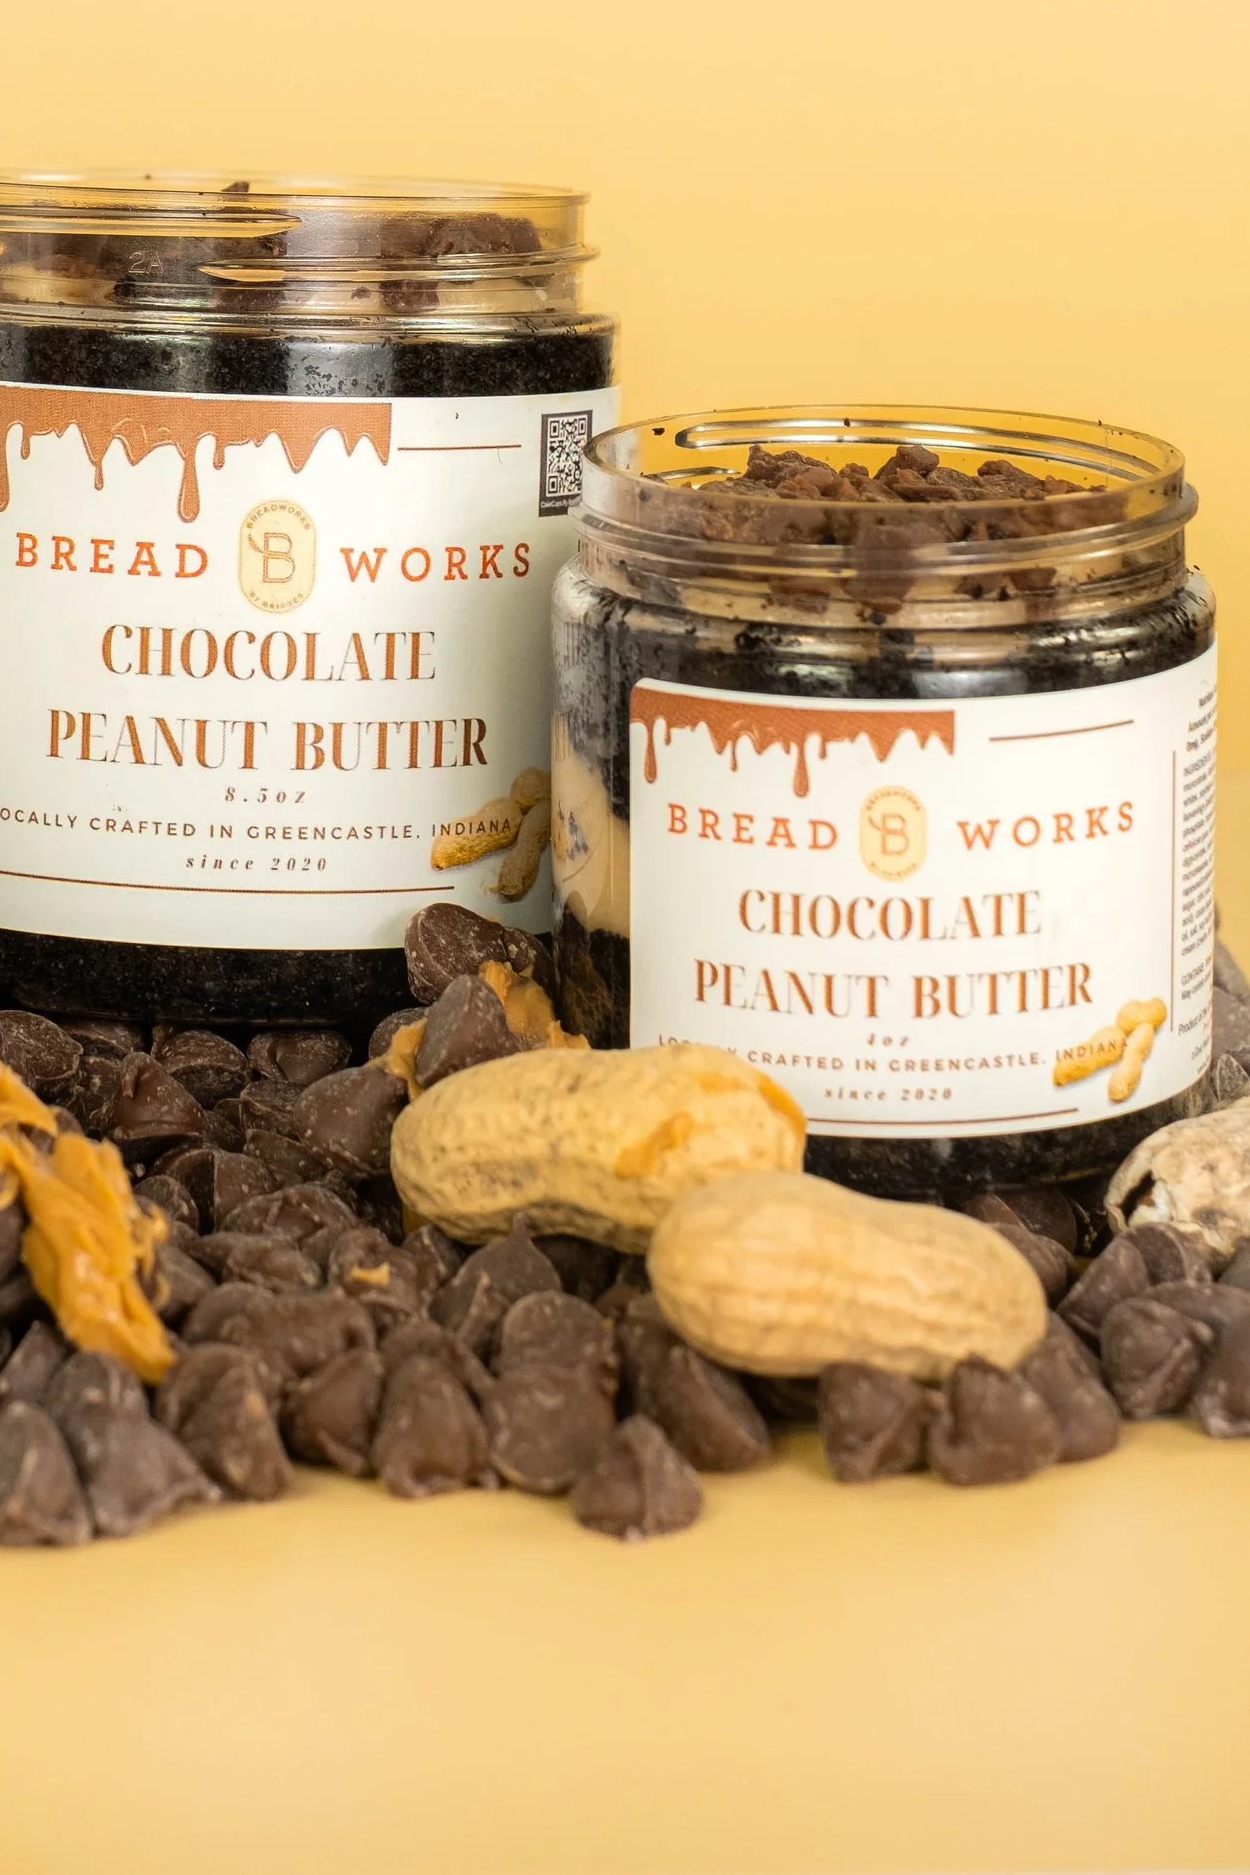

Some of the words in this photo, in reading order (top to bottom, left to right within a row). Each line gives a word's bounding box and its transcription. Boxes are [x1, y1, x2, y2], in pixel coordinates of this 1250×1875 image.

[14, 532, 209, 579] BREAD
[339, 542, 532, 584] WORKS
[101, 623, 436, 683] CHOCOLATE
[45, 708, 268, 771] PEANUT
[290, 717, 489, 772] BUTTER
[89, 817, 197, 838] CRAFTED
[209, 824, 234, 839] IN
[246, 824, 421, 841] GREENCASTLE,
[431, 816, 512, 838] INDIANA
[667, 802, 839, 852] BREAD
[957, 800, 1135, 852] WORKS
[185, 854, 254, 871] since
[270, 857, 327, 872] 2020
[738, 889, 1042, 942] CHOCOLATE
[693, 958, 890, 1019] PEANUT
[912, 962, 1094, 1020] BUTTER
[747, 1050, 845, 1071] CRAFTED
[854, 1057, 879, 1073] IN
[1055, 1036, 1128, 1062] INDIANA
[823, 1085, 888, 1102] since
[900, 1086, 954, 1102] 2020
